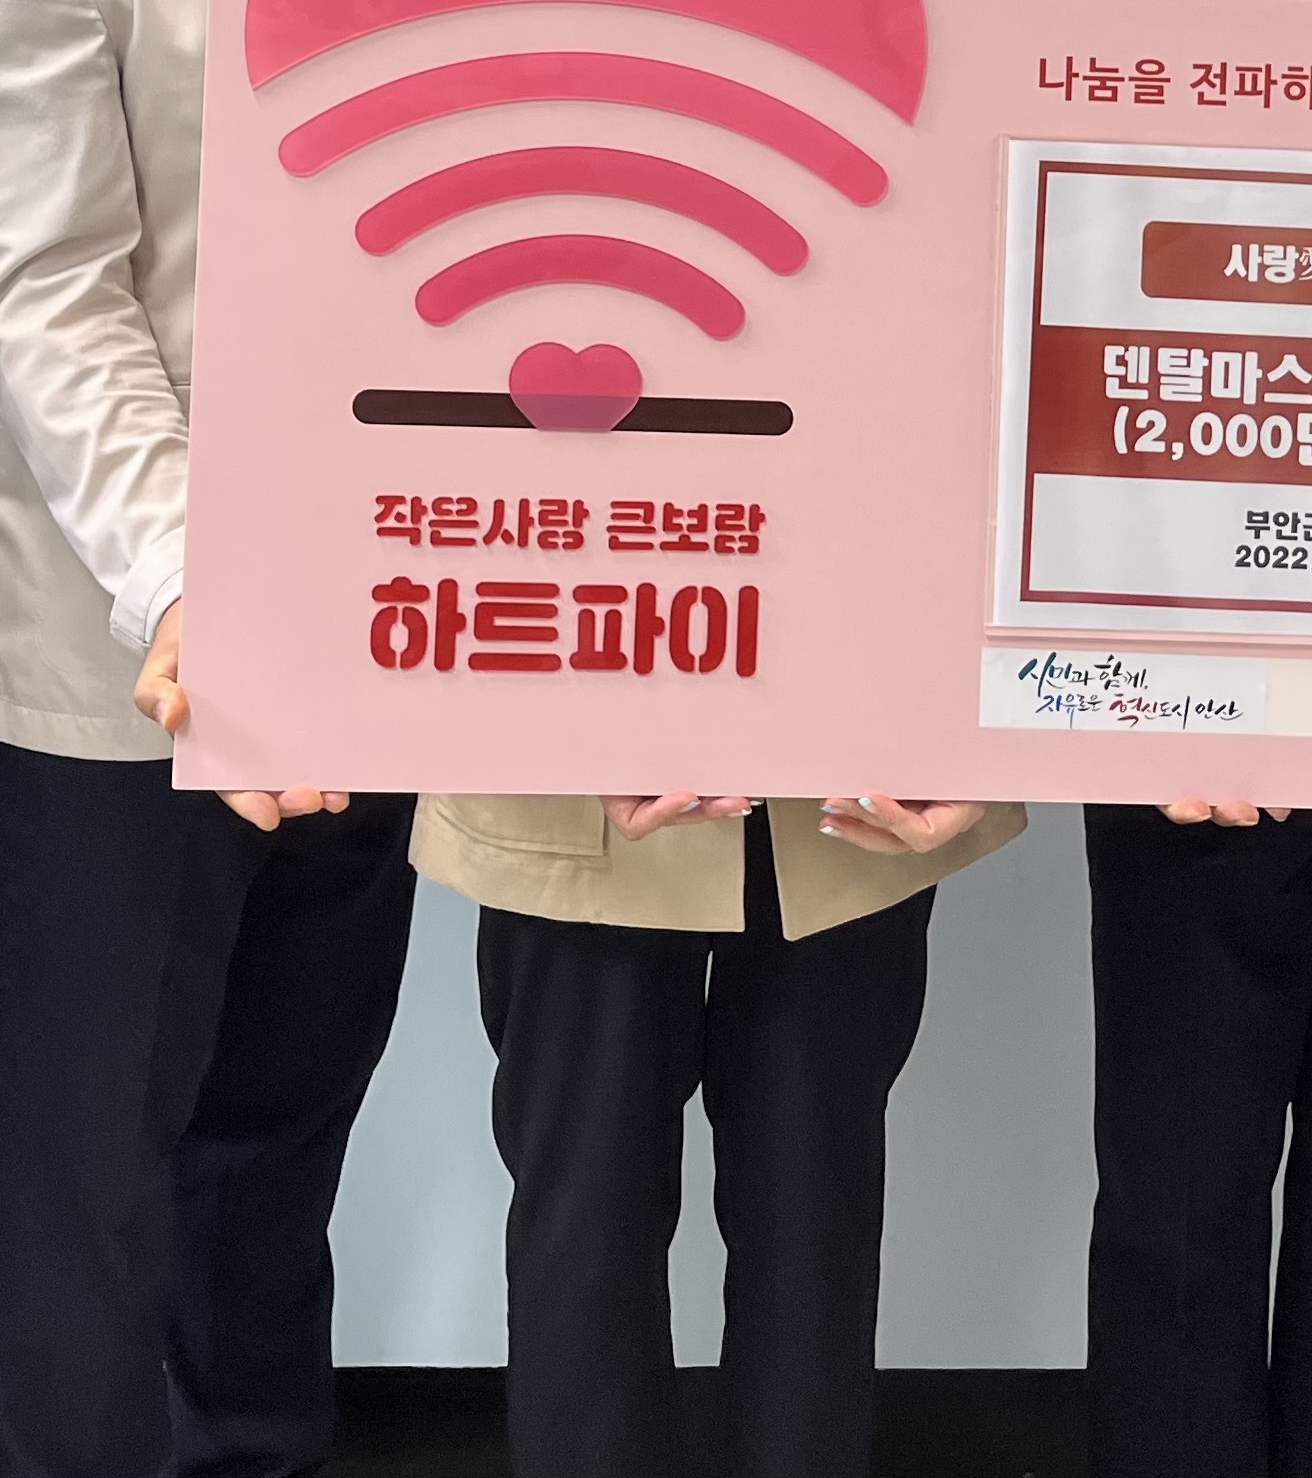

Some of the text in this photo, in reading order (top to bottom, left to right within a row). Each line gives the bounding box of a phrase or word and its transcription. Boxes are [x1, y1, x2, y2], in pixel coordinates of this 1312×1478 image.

[1038, 54, 1172, 105] 나눔을
[372, 494, 767, 556] 작은사랑 큰보람
[369, 577, 761, 677] 하트파이
[1018, 652, 1093, 697] 시민과
[1035, 693, 1243, 729] 자유로운 혁신도시 안산
